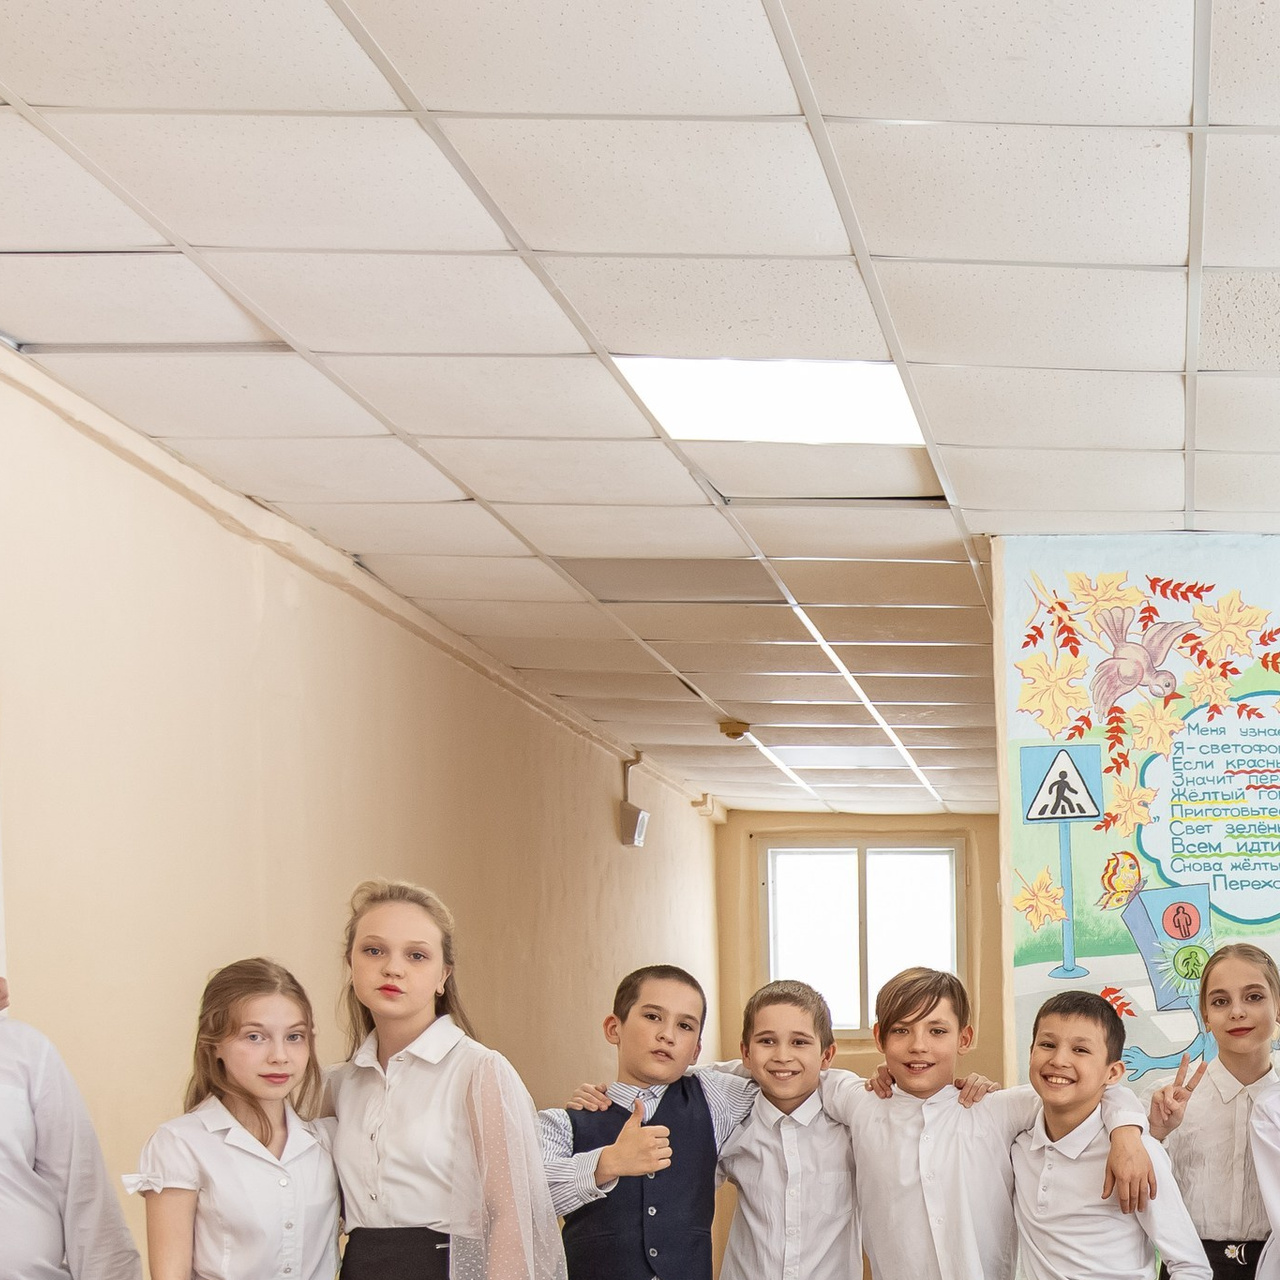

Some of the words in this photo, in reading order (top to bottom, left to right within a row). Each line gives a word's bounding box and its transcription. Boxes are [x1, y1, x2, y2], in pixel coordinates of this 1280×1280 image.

[1187, 722, 1227, 736] Меня
[1172, 756, 1214, 771] Если
[1172, 771, 1235, 787] Значит
[1170, 787, 1246, 803] Жёлтый
[1169, 820, 1213, 836] Свет
[1171, 837, 1222, 854] Всем
[1170, 857, 1223, 873] Снова
